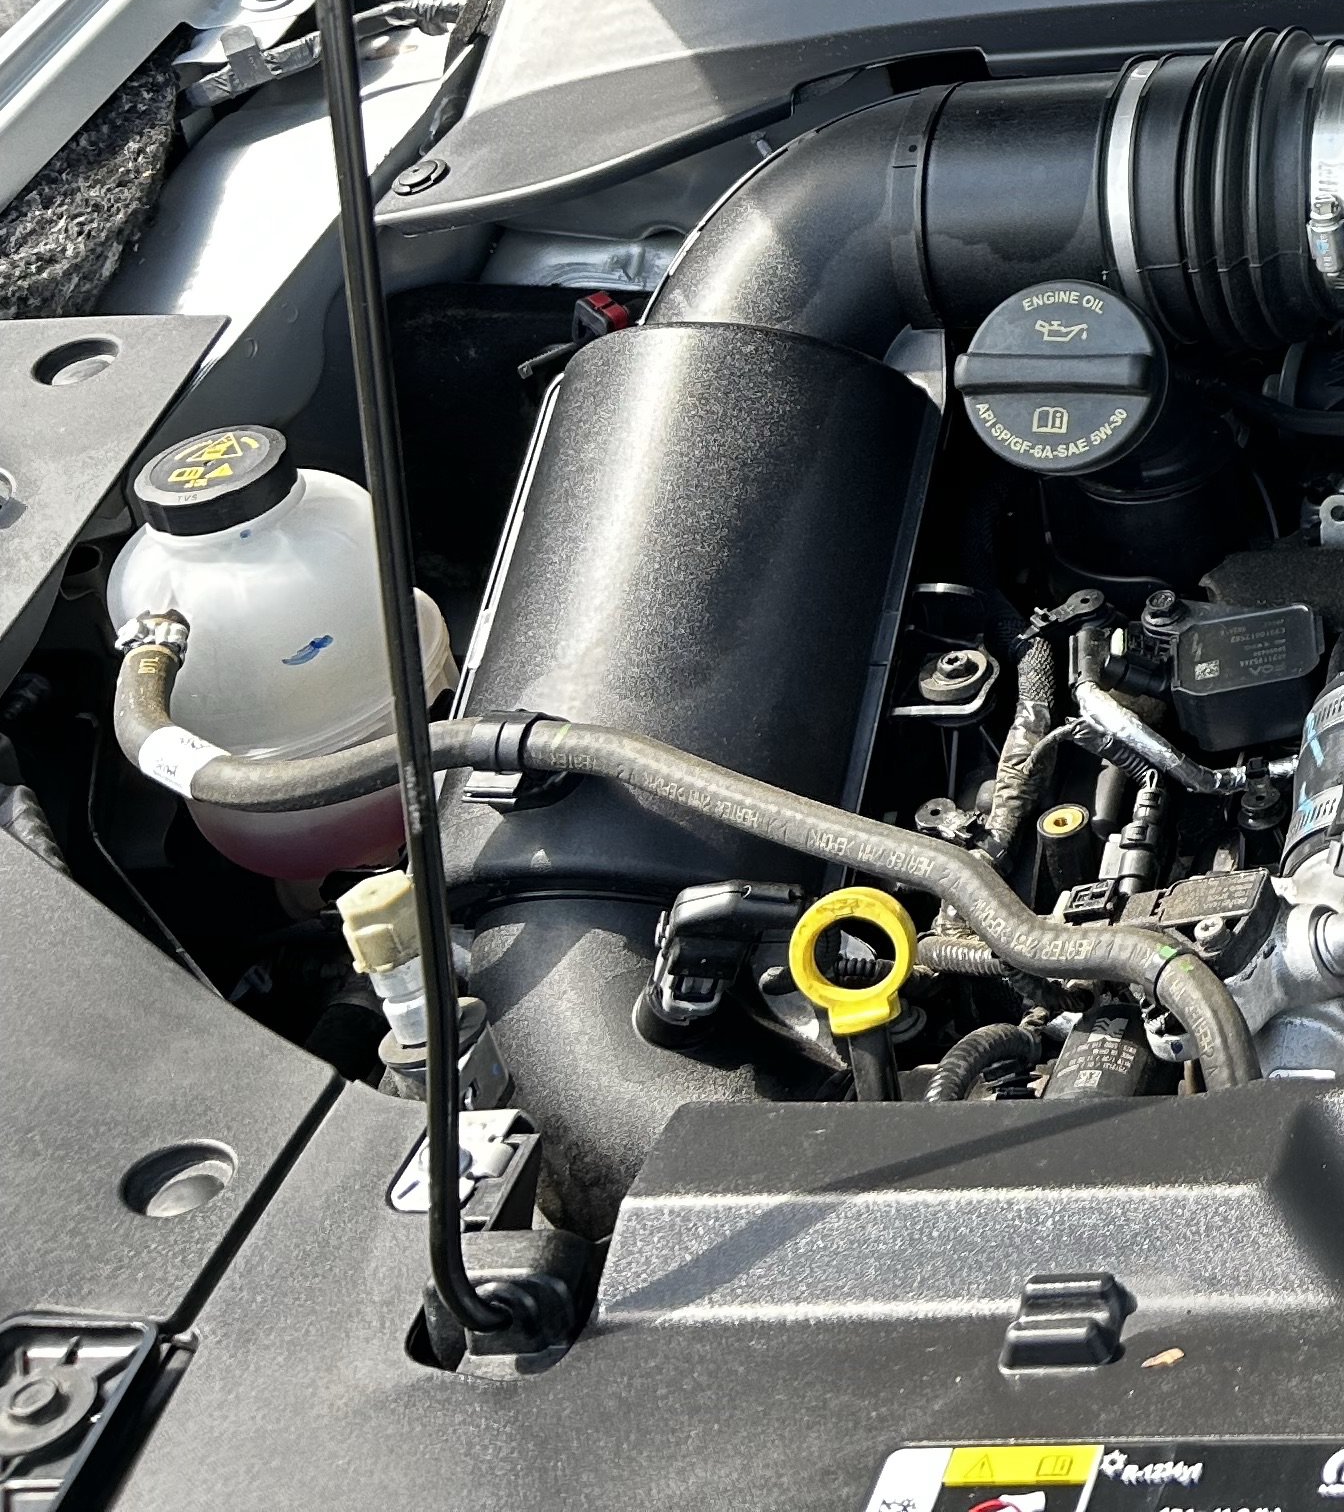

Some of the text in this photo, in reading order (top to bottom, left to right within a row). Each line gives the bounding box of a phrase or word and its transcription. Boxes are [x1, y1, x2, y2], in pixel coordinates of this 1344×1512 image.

[1022, 291, 1105, 315] ENGINE OIL
[976, 402, 996, 434] API
[1091, 407, 1129, 447] 5W-30
[884, 843, 938, 878] HEATER
